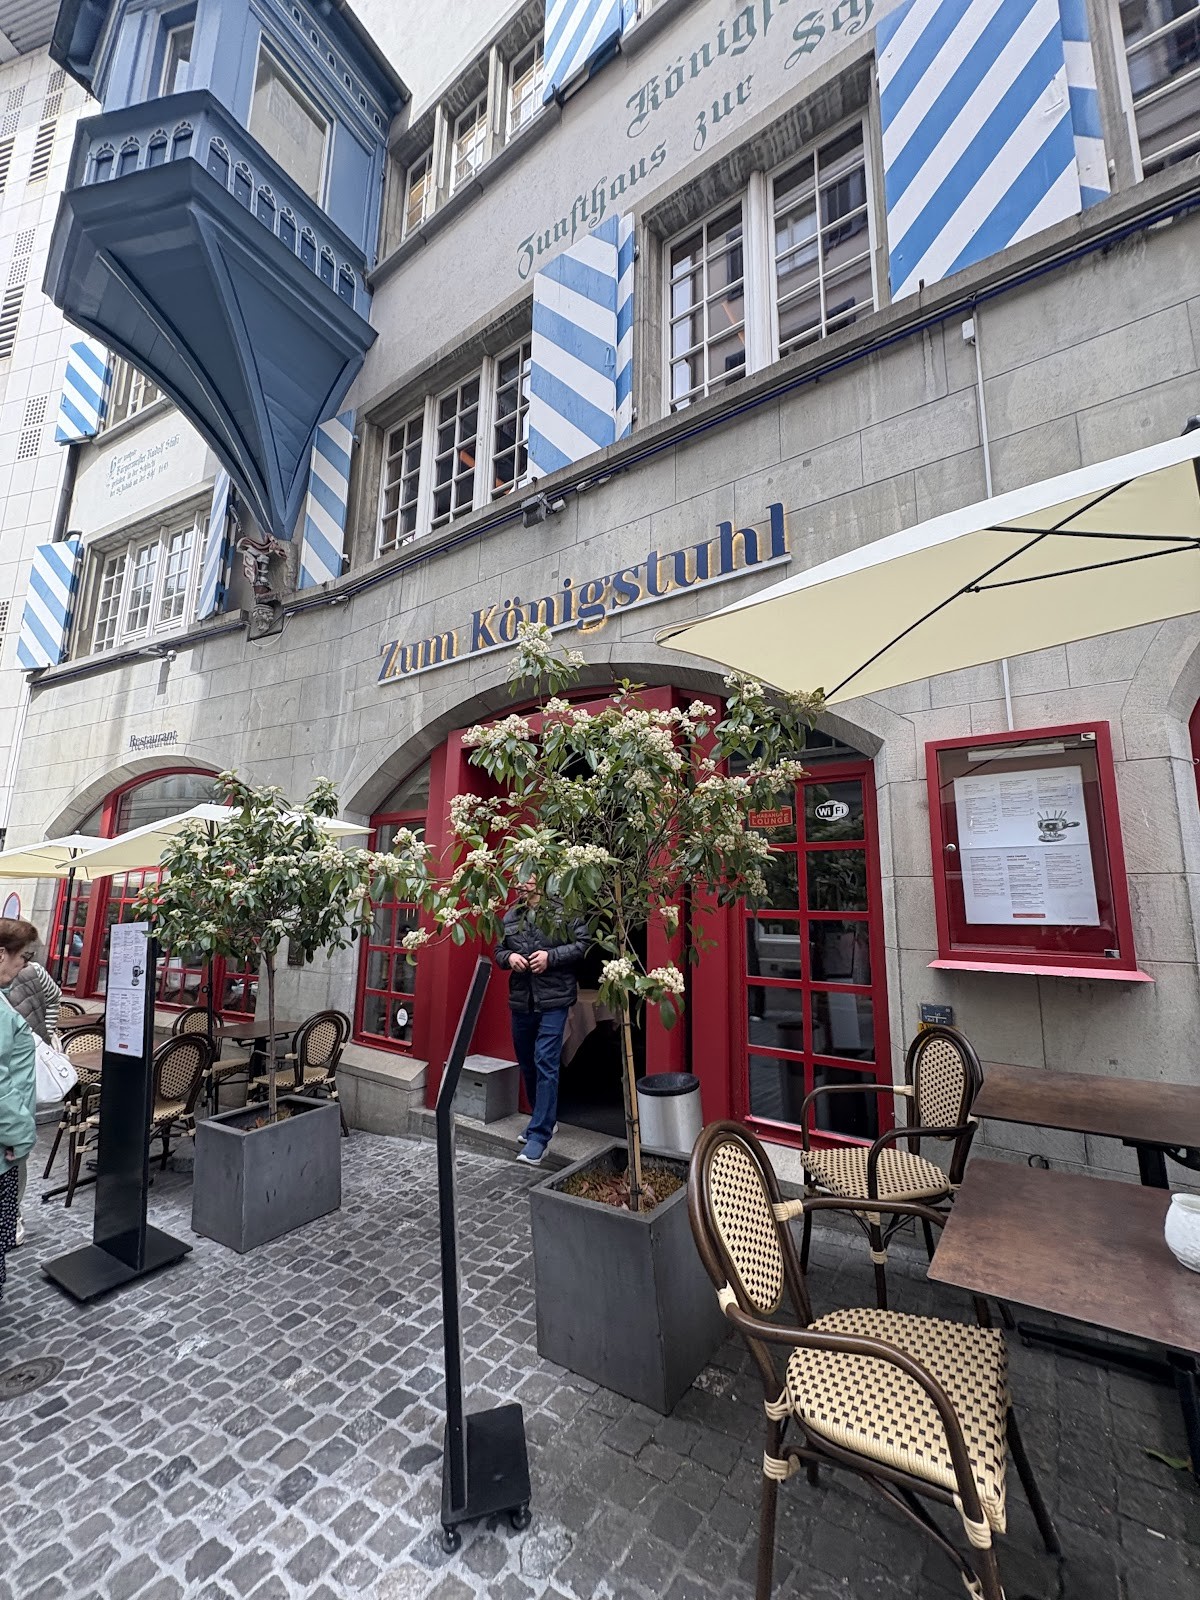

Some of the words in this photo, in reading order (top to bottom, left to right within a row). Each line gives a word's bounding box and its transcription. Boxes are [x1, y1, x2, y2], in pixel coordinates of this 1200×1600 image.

[517, 139, 667, 280] Zunfthaus
[693, 72, 755, 151] zur
[376, 629, 459, 681] Zum
[470, 502, 791, 653] Königstuhl
[129, 730, 178, 748] Restaurant
[751, 815, 789, 825] LOUNGE
